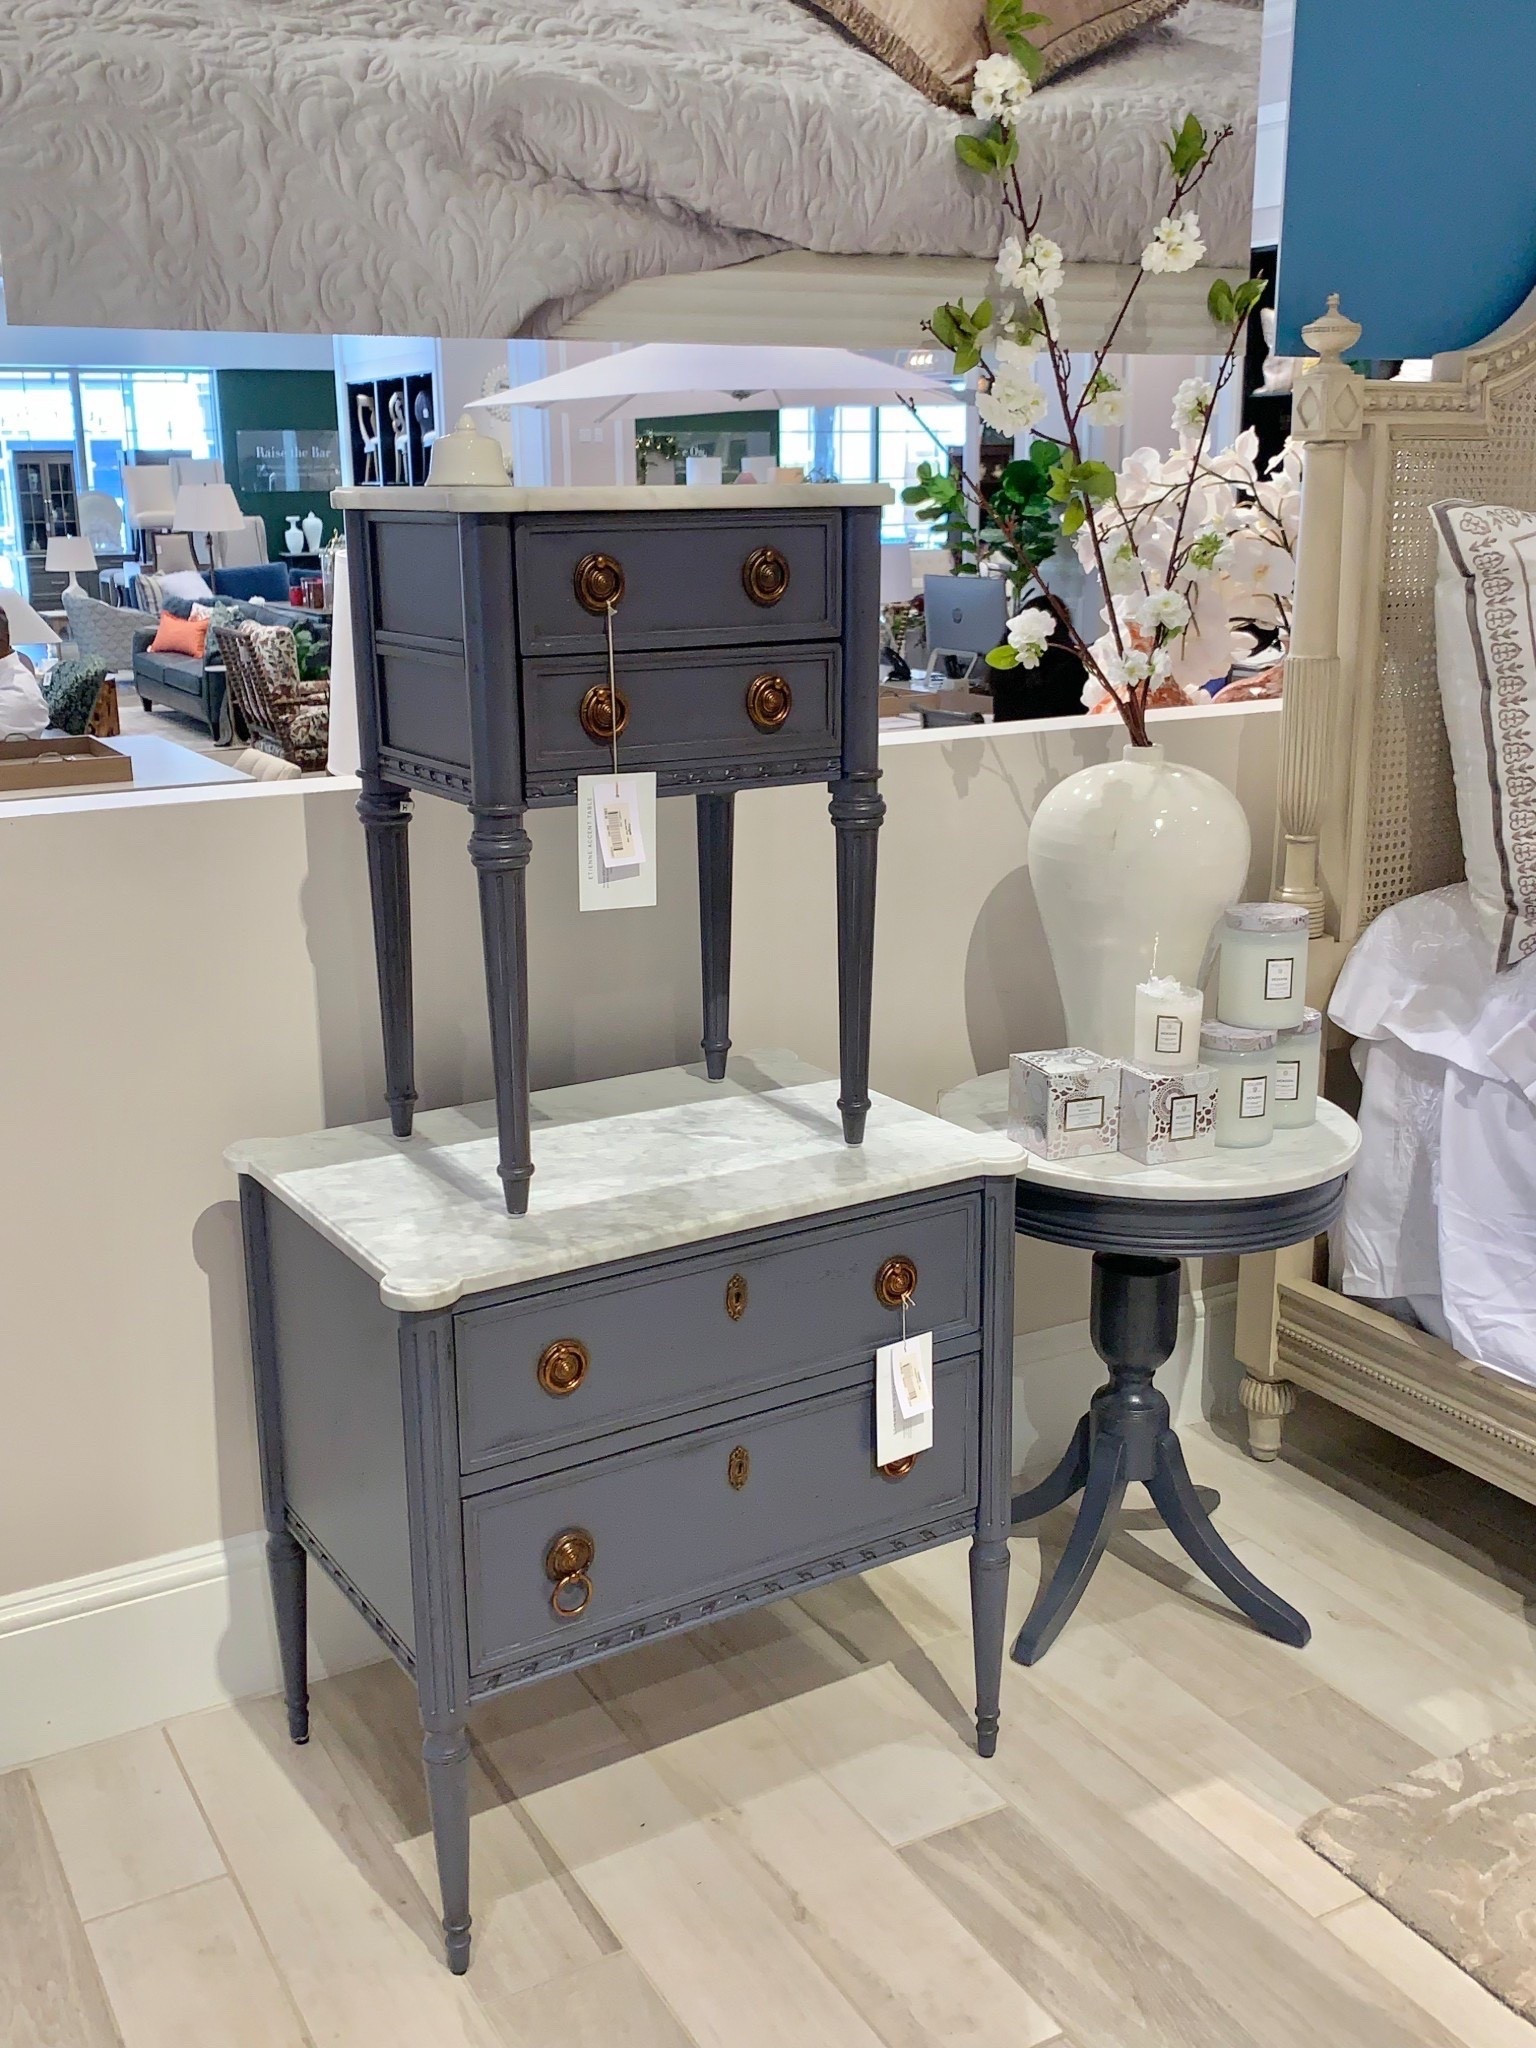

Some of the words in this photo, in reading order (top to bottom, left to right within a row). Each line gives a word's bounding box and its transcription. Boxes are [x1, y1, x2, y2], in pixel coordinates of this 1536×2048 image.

[256, 445, 287, 458] Raise
[290, 445, 308, 458] the
[311, 445, 331, 458] Bar
[586, 850, 594, 880] ETIENNE
